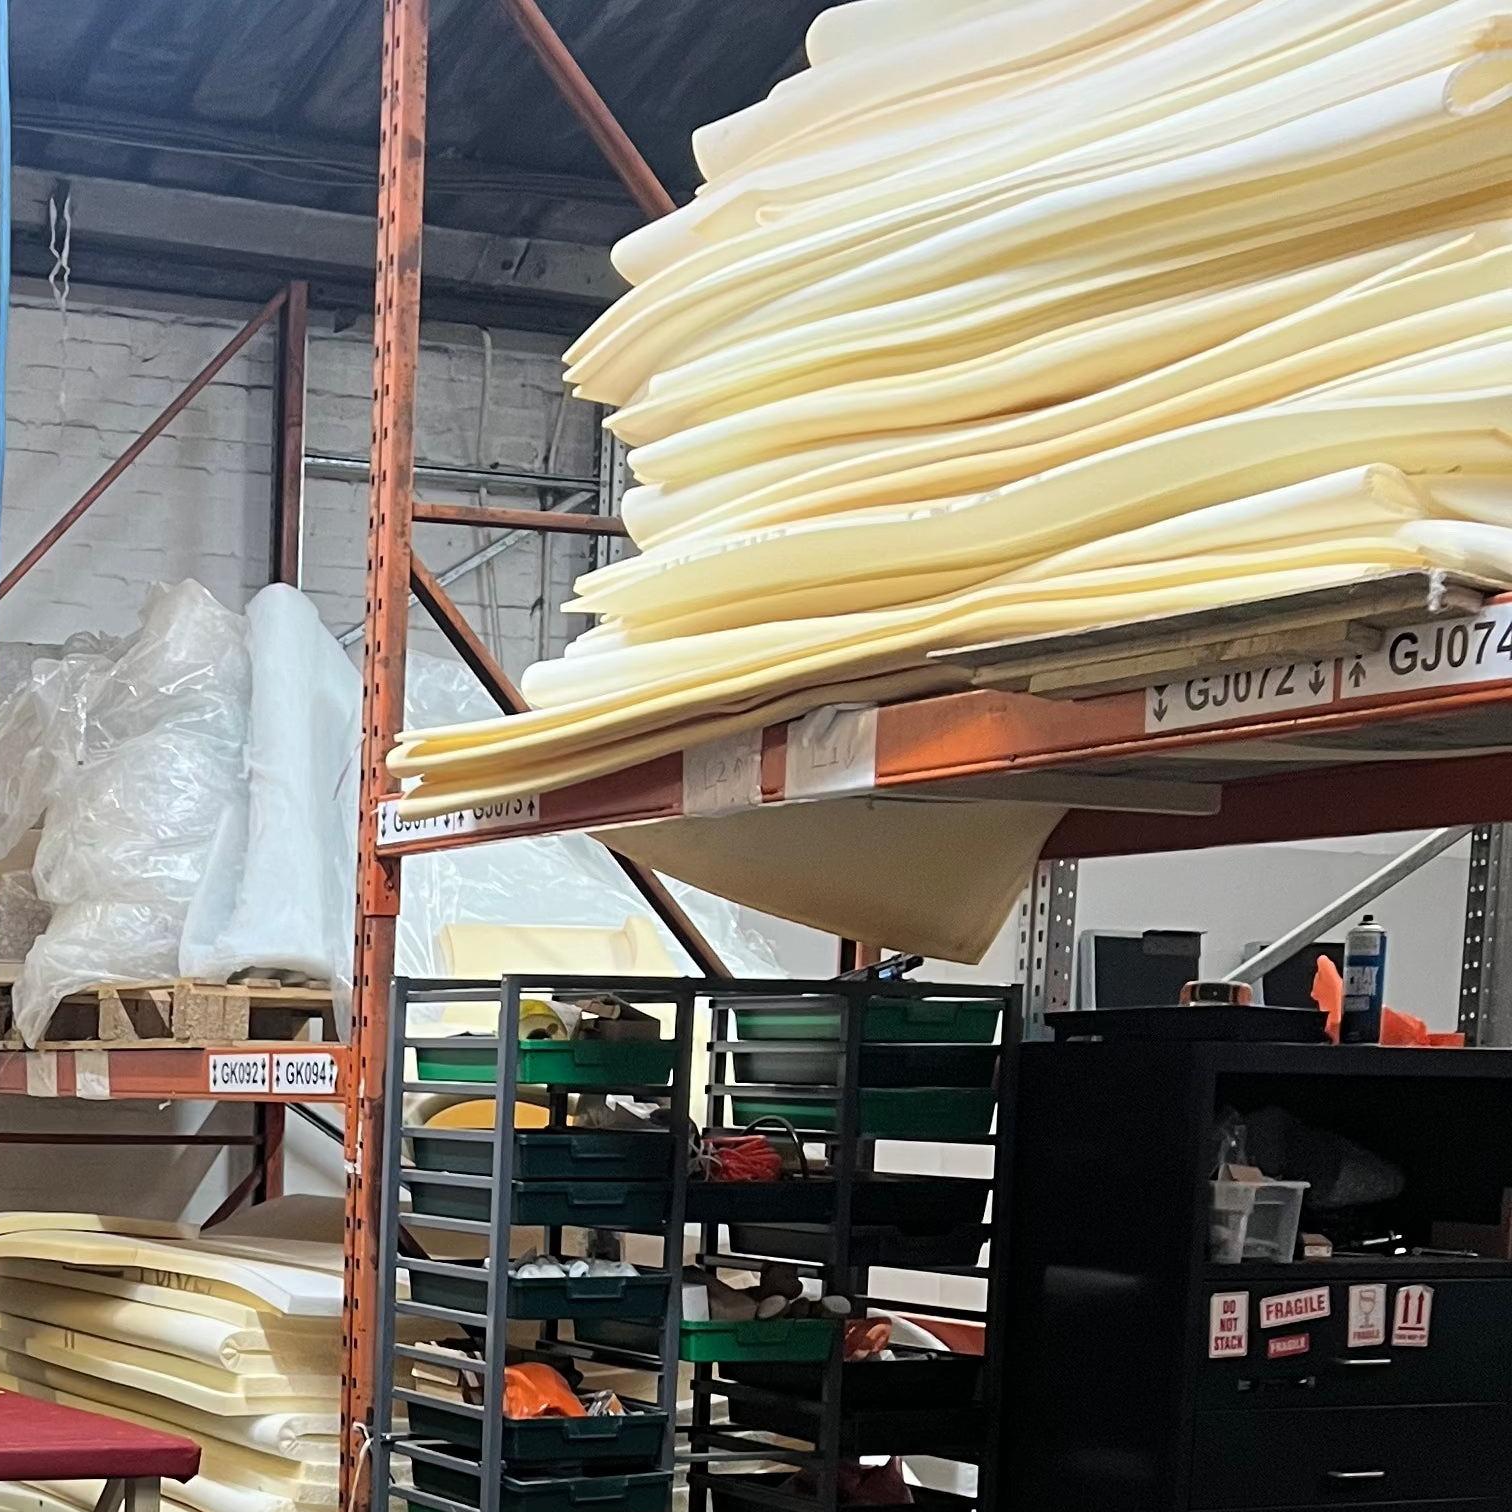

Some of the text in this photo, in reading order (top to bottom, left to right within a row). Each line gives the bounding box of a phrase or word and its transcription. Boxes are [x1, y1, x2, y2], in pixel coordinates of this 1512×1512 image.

[1389, 621, 1512, 676] GJ074
[221, 1061, 258, 1084] GK092
[286, 1061, 327, 1084] GK094
[1223, 1300, 1237, 1314] DO
[1265, 1294, 1326, 1321] FRAGILE
[1219, 1317, 1239, 1332] NOT
[1213, 1335, 1244, 1351] STACK
